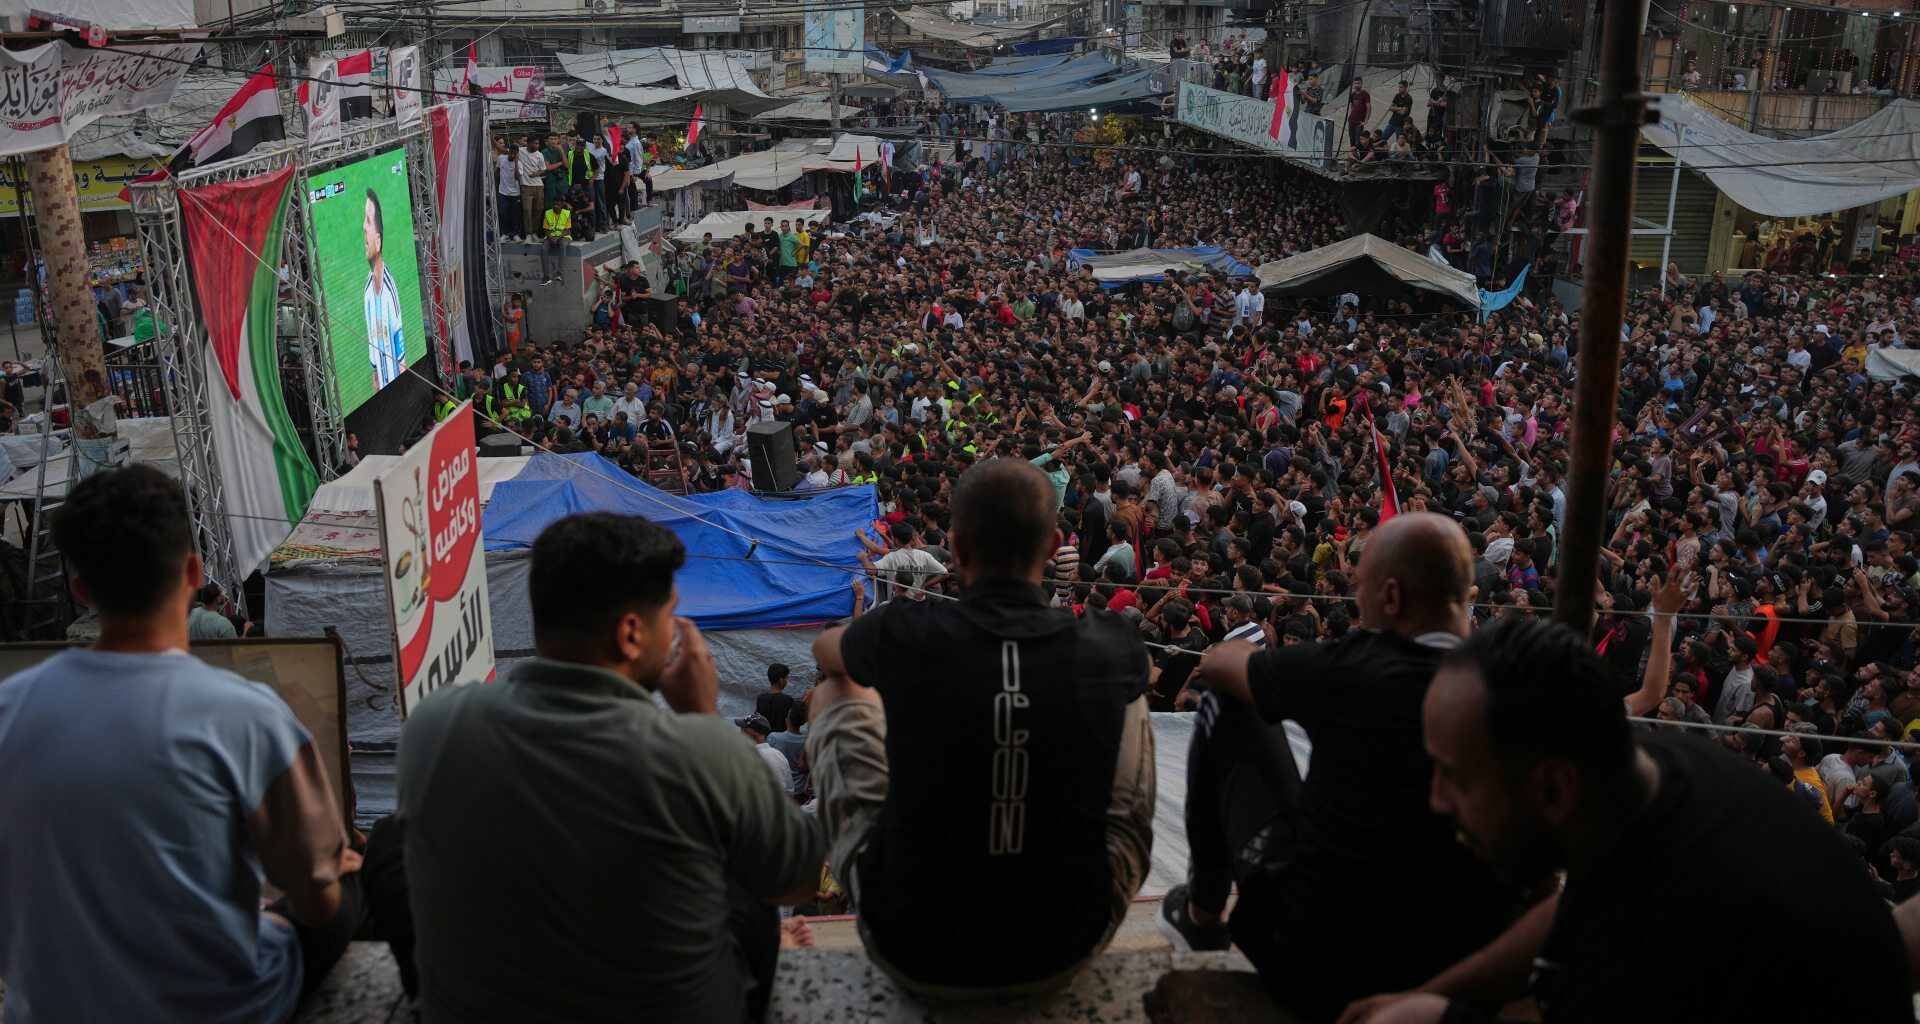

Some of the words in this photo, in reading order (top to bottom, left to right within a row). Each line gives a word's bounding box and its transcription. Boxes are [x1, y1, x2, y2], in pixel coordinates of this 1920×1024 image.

[94, 162, 157, 187] كتبة
[433, 448, 470, 512] معرض
[434, 496, 476, 563] وكافيه
[418, 584, 484, 700] الأسو
[989, 640, 1030, 856] ICON
